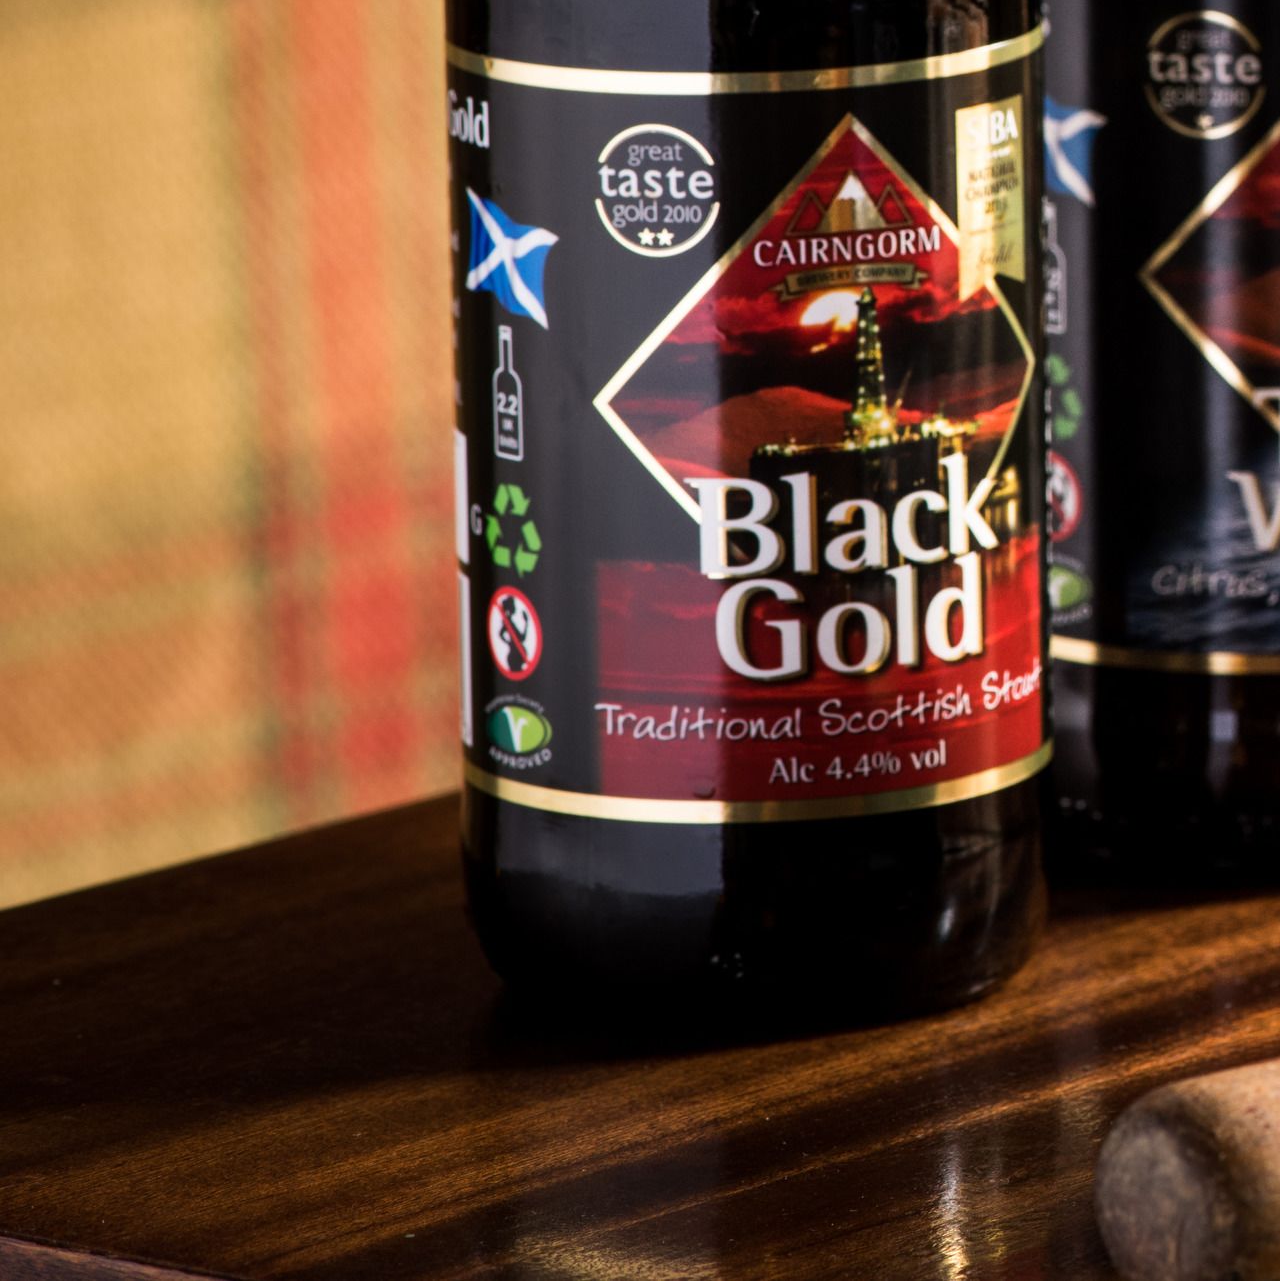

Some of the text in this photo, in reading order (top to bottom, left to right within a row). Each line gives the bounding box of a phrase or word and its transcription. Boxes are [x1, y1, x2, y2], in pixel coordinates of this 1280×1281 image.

[1148, 50, 1262, 84] taste
[628, 143, 683, 167] great
[598, 164, 714, 199] taste
[612, 199, 702, 228] gold 2010
[753, 224, 941, 268] CAIRNGORM
[684, 453, 998, 579] Black
[715, 551, 984, 682] Gold
[594, 702, 802, 741] Traditional
[818, 682, 971, 736] Scottish
[769, 738, 947, 785] Alc 4.4% vol
